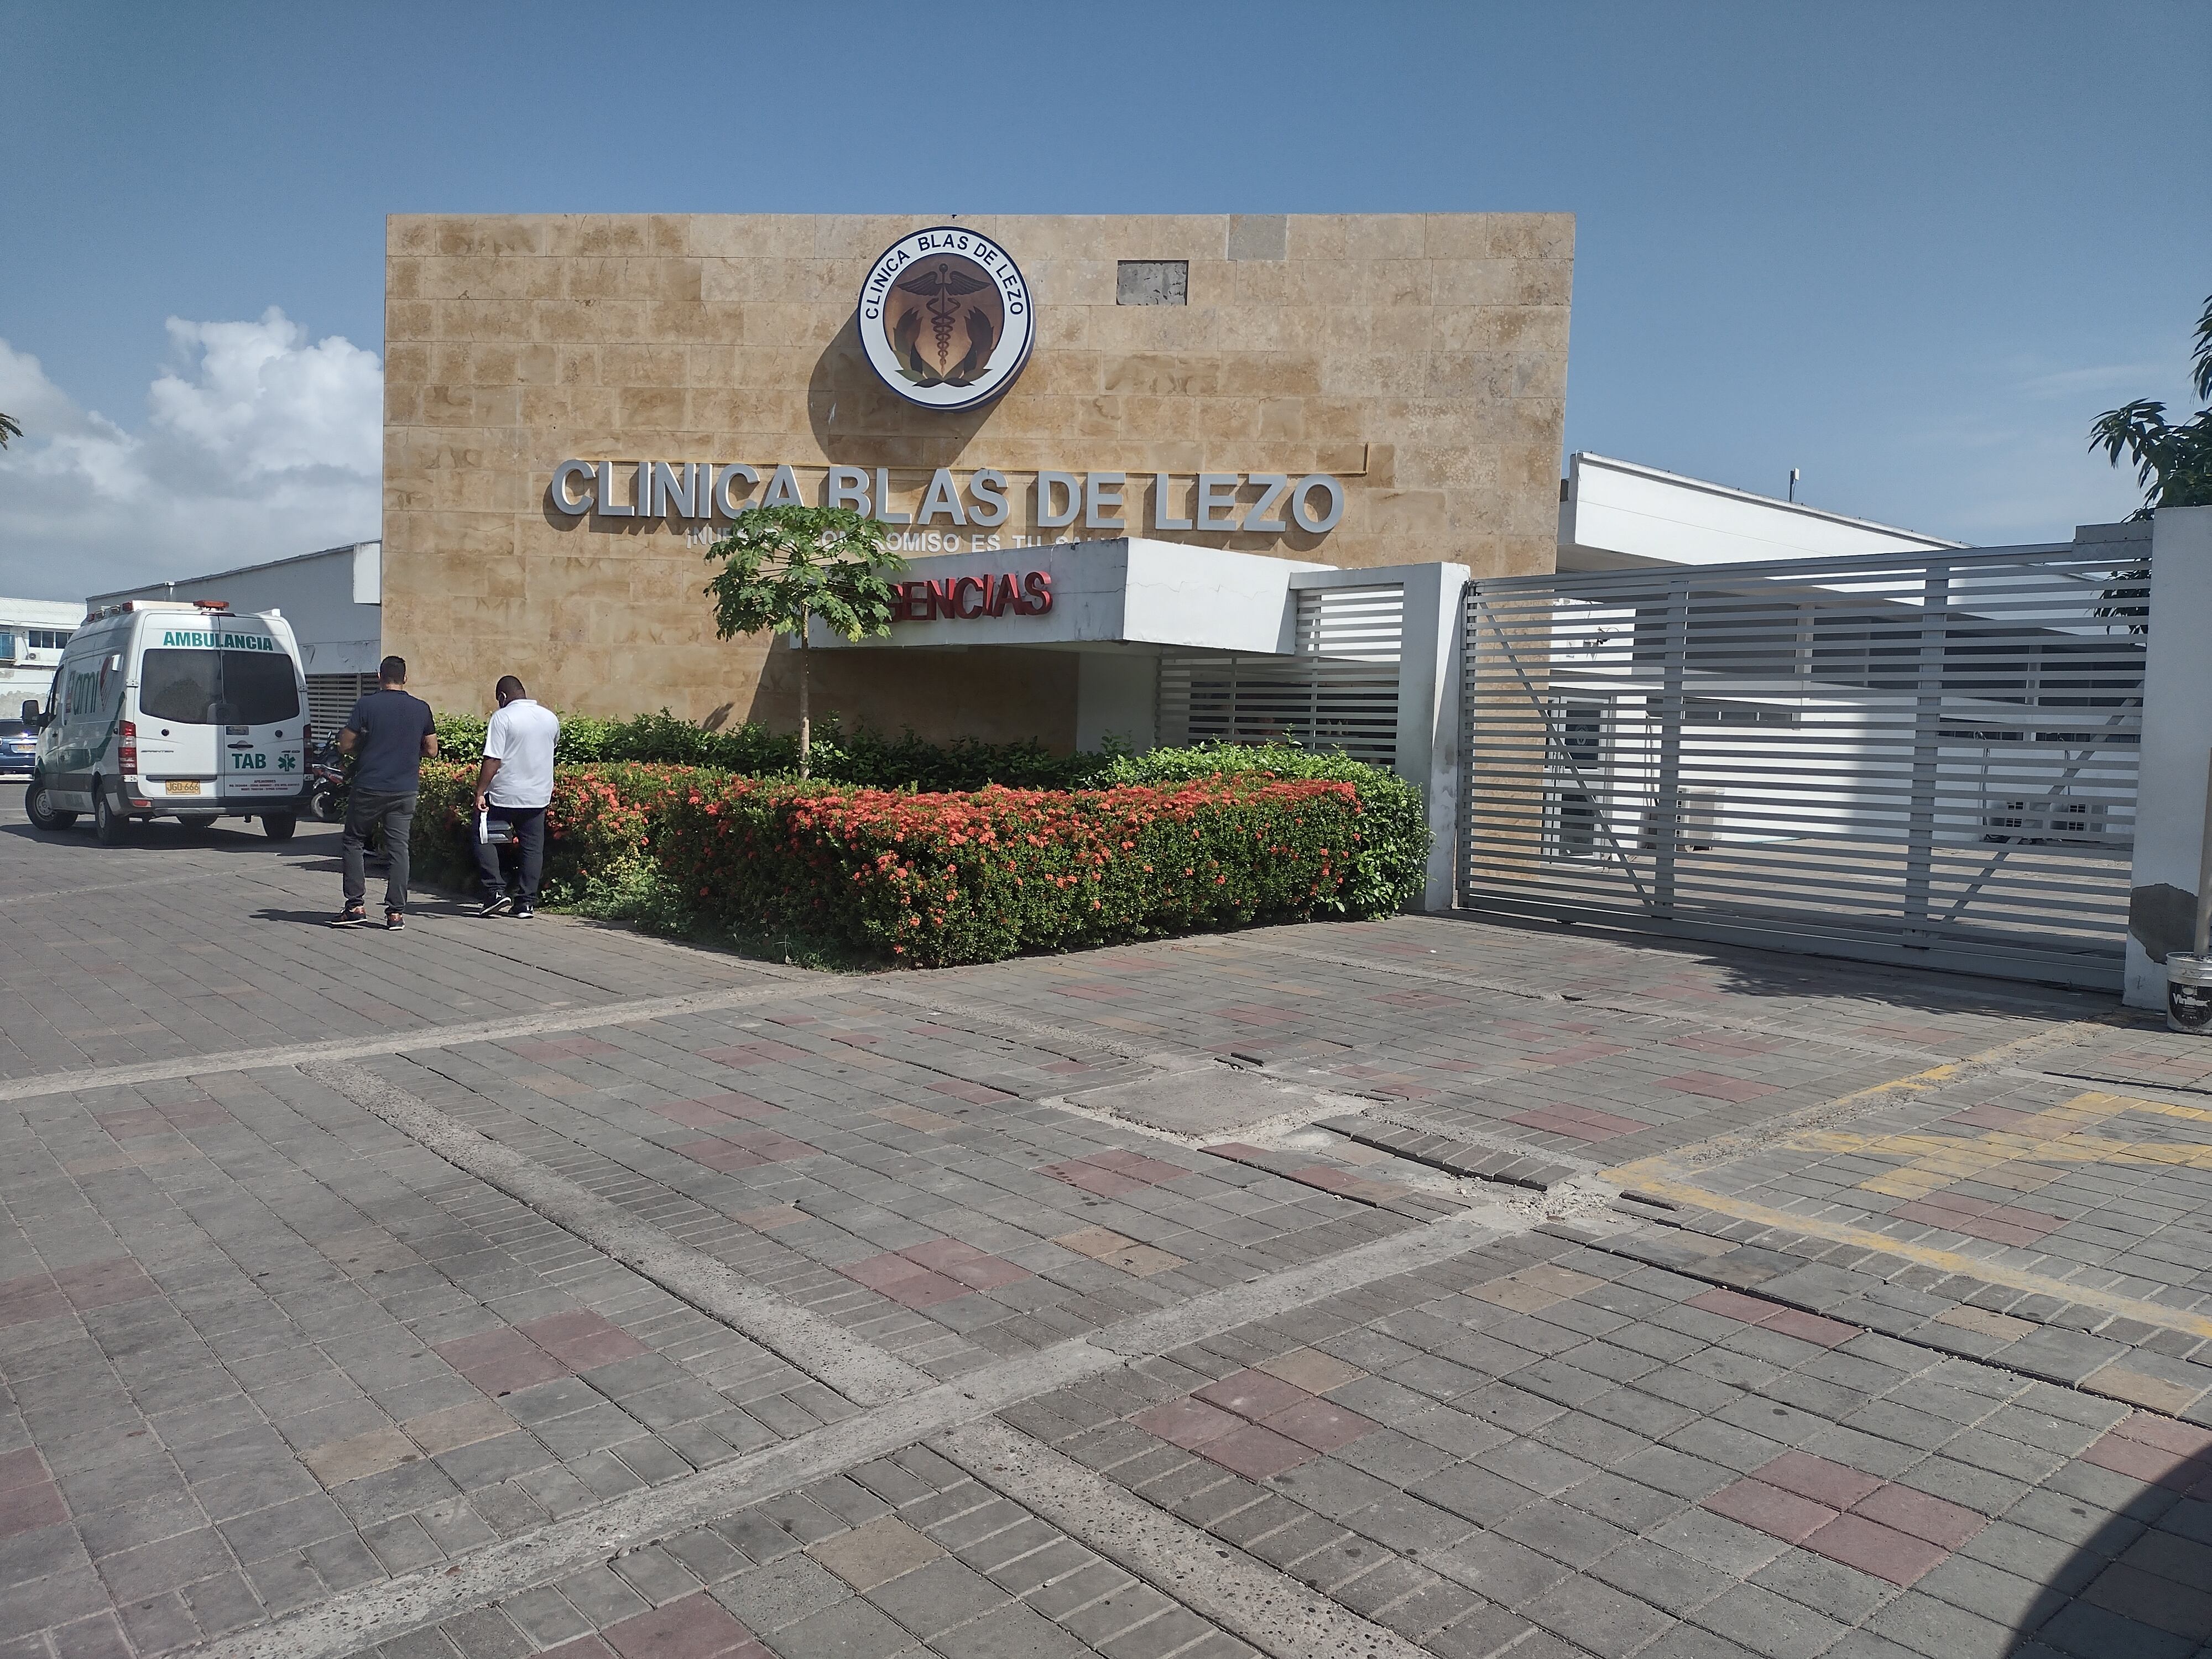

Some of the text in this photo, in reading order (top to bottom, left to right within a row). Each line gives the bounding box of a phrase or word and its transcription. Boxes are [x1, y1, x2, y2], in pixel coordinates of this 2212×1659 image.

[865, 233, 1024, 320] CLINICA BLAS DE LEZO
[552, 459, 1344, 534] CLINICA BLAS DE LEZO
[972, 534, 1001, 552] ES
[826, 571, 1053, 623] GENCIAS
[163, 631, 273, 651] AMBULANCIA
[232, 753, 267, 769] TAB
